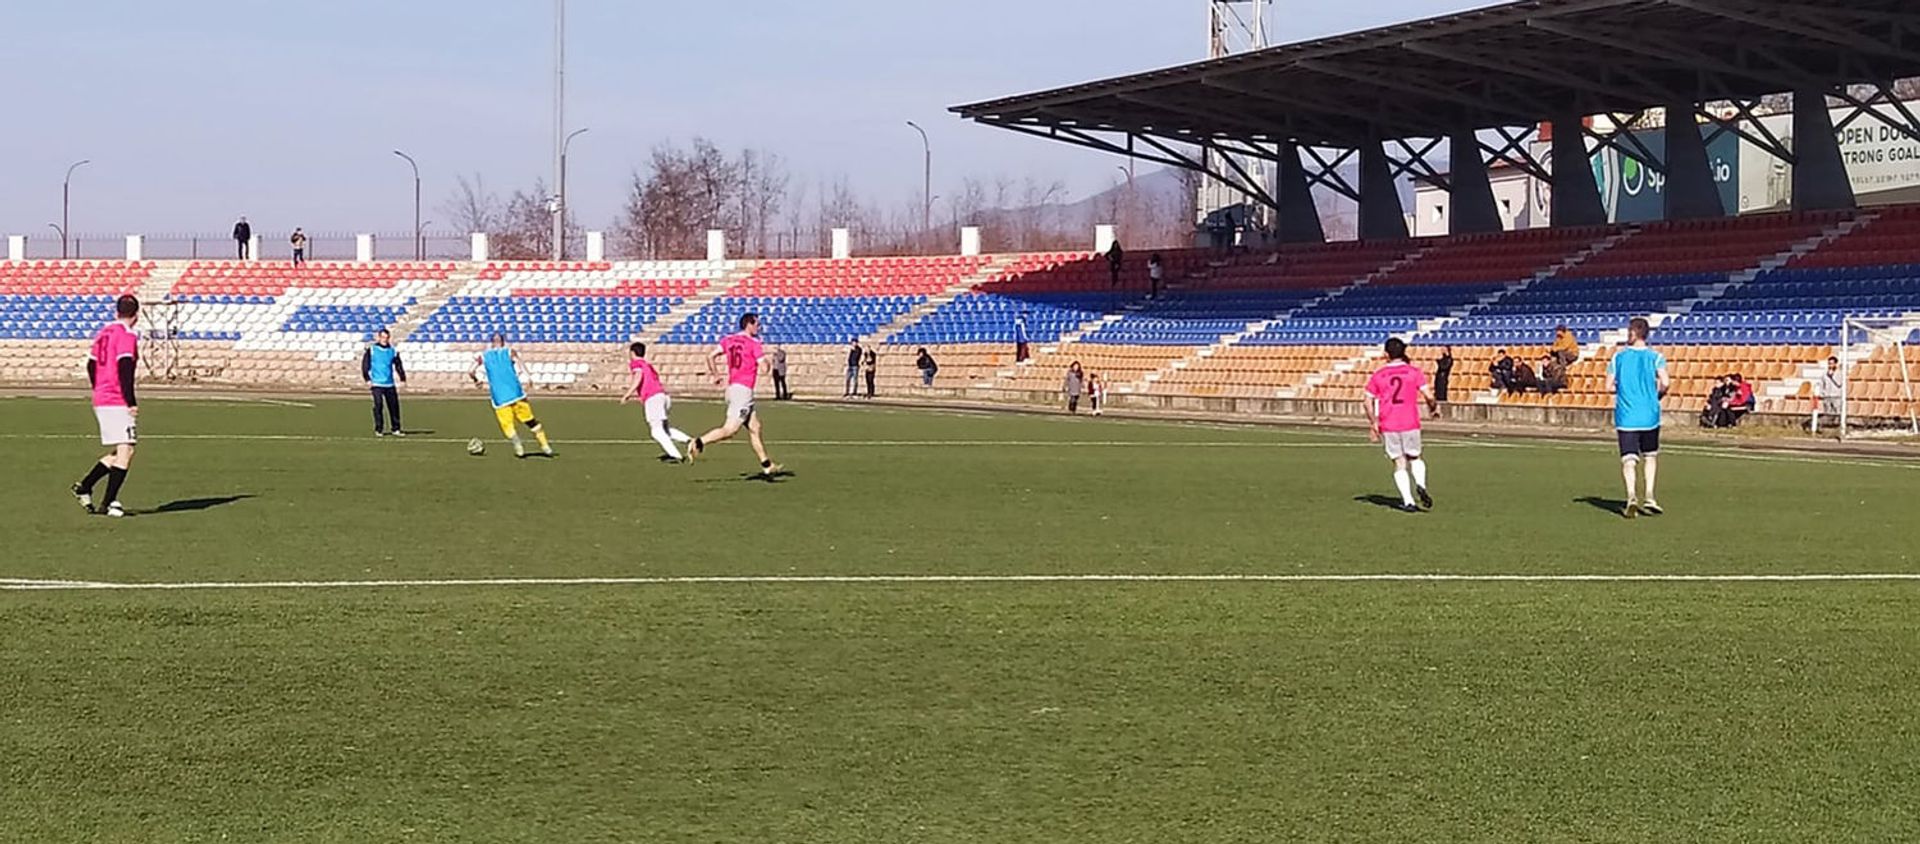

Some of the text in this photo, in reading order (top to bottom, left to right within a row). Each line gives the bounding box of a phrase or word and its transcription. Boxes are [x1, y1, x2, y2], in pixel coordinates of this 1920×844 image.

[1837, 127, 1873, 145] OPEN
[728, 345, 743, 370] 16
[1390, 376, 1404, 404] 2
